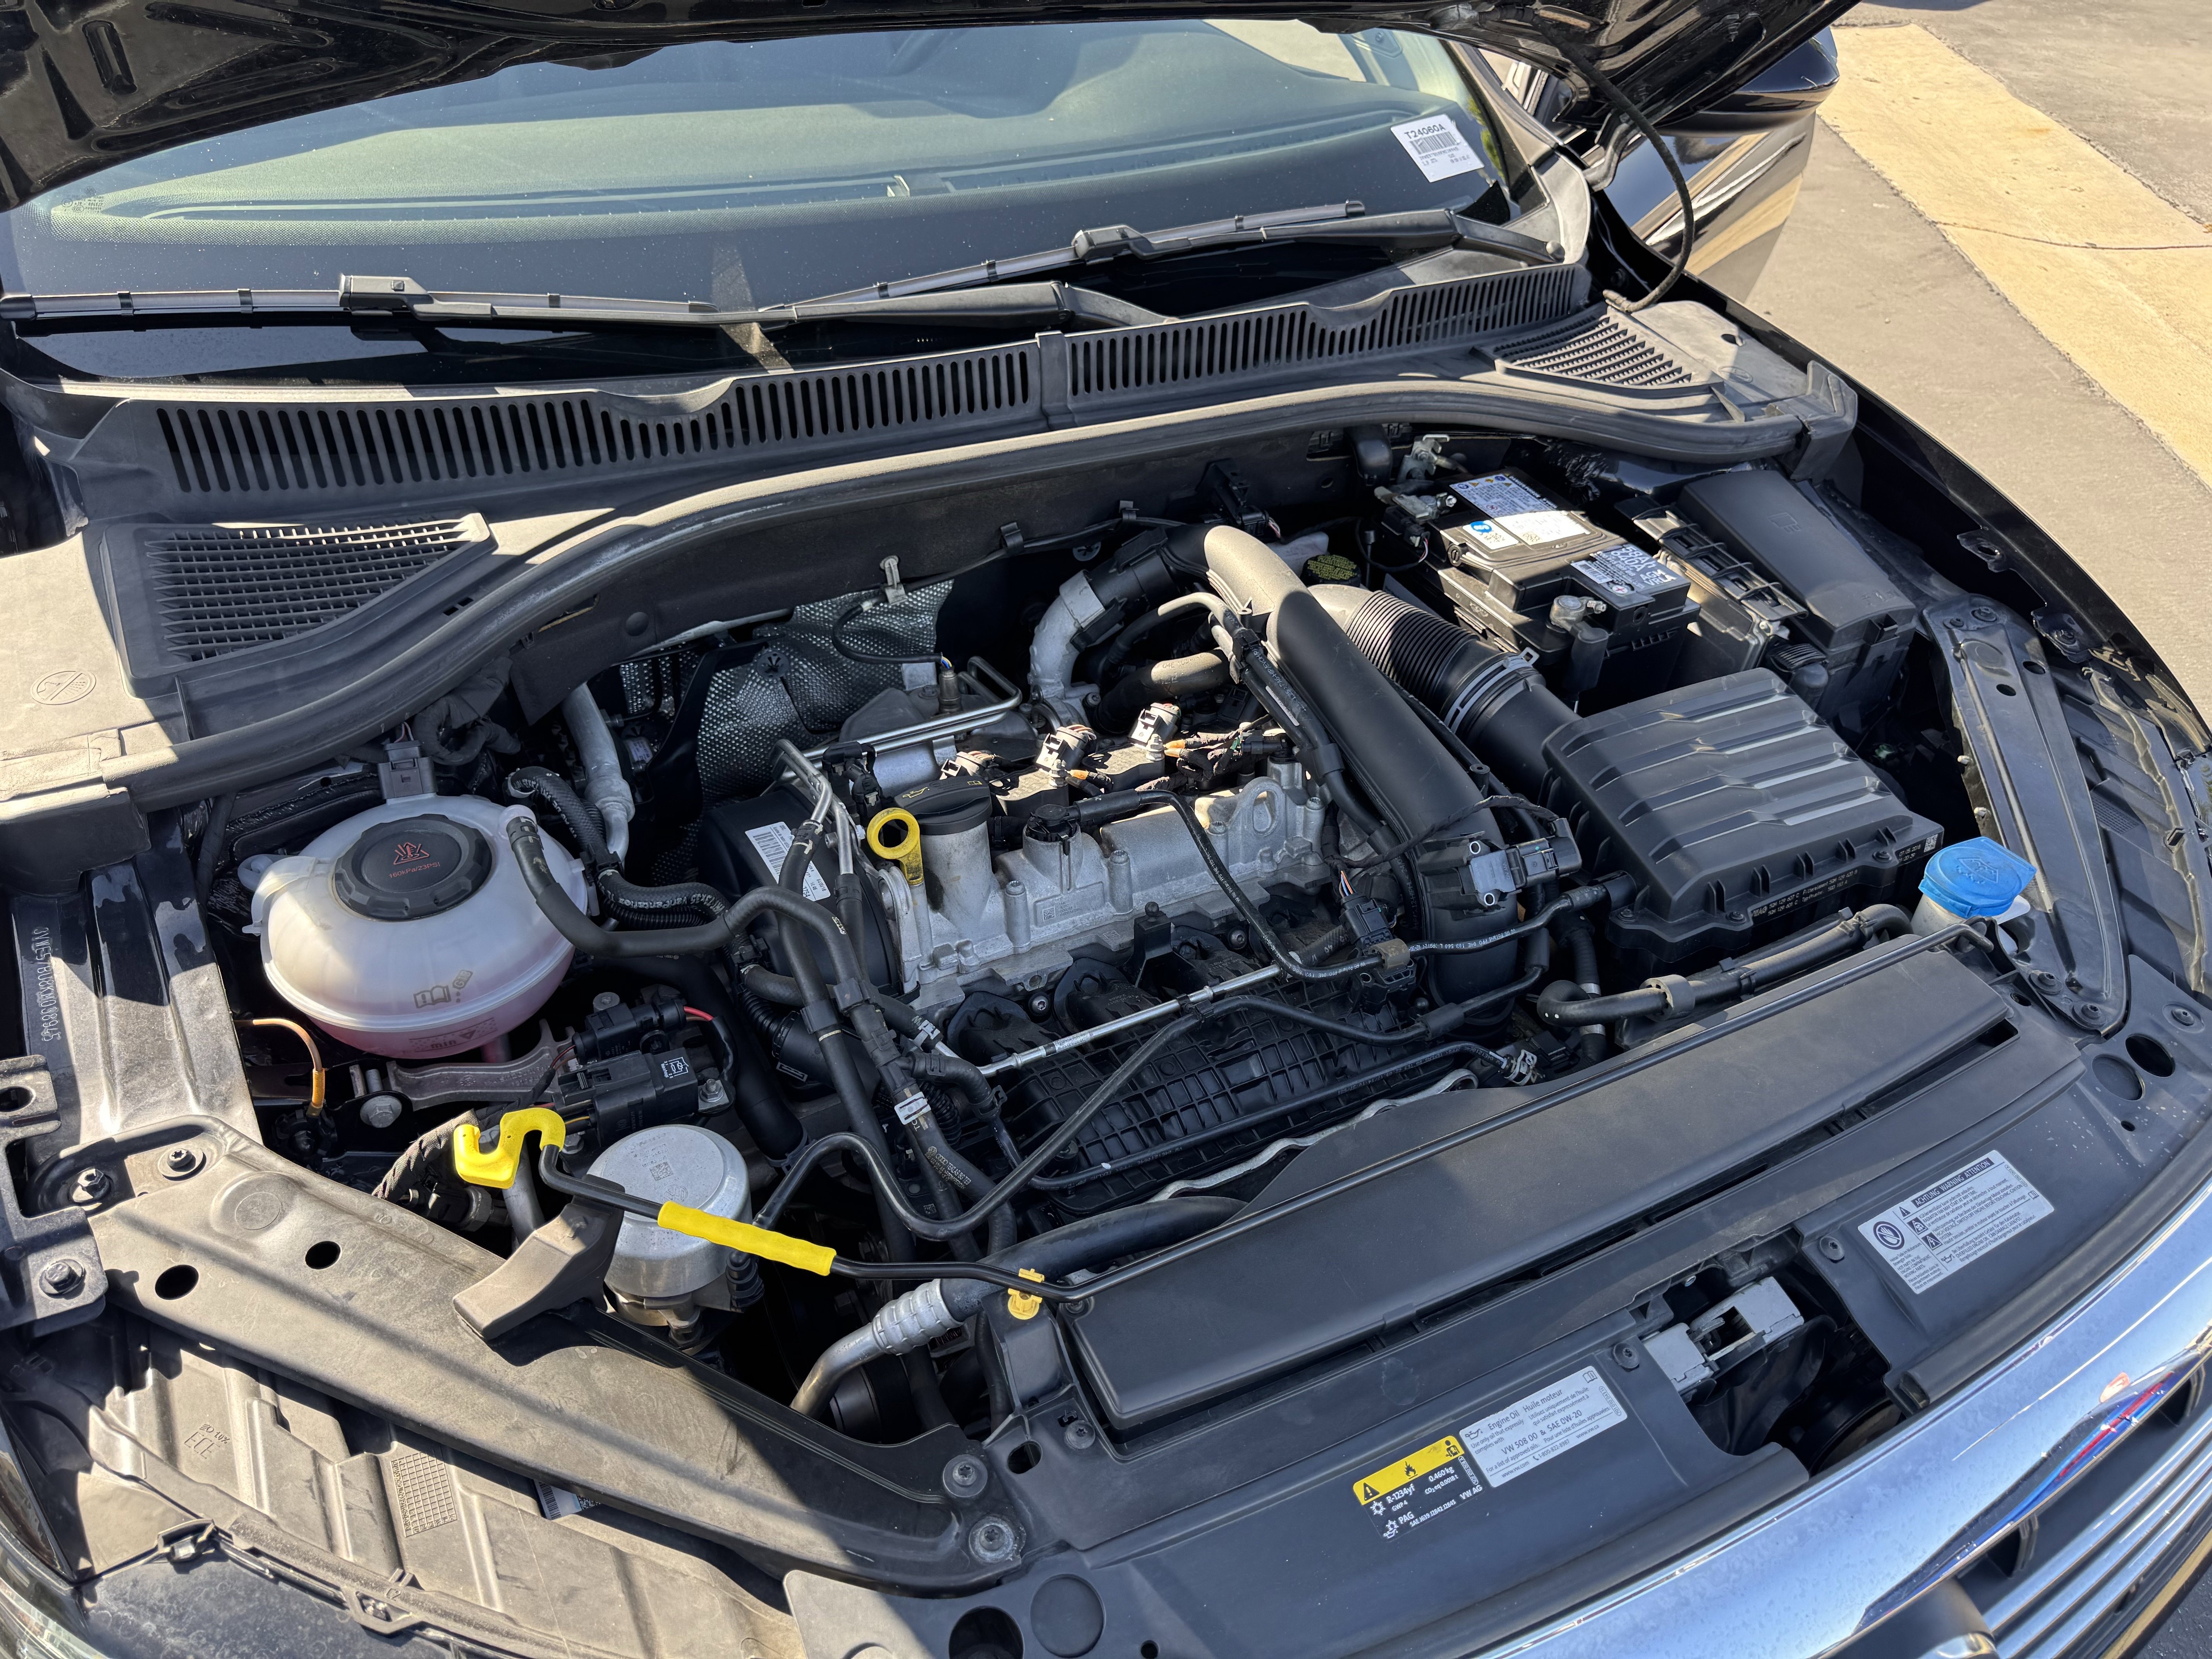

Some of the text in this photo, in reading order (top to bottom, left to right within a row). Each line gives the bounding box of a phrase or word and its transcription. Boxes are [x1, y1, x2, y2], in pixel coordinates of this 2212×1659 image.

[1403, 123, 1446, 139] T24060A
[1611, 551, 1645, 572] 640A
[1622, 546, 1657, 568] 58Ah
[1640, 569, 1666, 580] AGM
[1644, 574, 1677, 586] VRLA
[388, 860, 442, 879] 160kPa/23PSI
[1488, 933, 1504, 941] Poland
[431, 1037, 457, 1050] min
[946, 1162, 961, 1176] TEKLAS
[957, 1171, 965, 1180] BG
[1915, 1160, 1990, 1206] ACHTUNG WARNING ATTENTION
[1522, 1389, 1563, 1412] Huile moteur
[1528, 1409, 1545, 1420] Utilisez
[1544, 1396, 1571, 1412] uniquement
[1575, 1387, 1589, 1396] l'huile
[1487, 1409, 1520, 1430] Engine Oil
[1540, 1410, 1558, 1422] satisfait
[1494, 1428, 1505, 1436] that
[1504, 1419, 1524, 1432] expressly
[1501, 1444, 1515, 1455] VW
[1514, 1437, 1528, 1448] 508
[1527, 1432, 1538, 1441] 00
[1546, 1420, 1561, 1431] SAE
[1559, 1409, 1582, 1425] 0W-20
[1543, 1435, 1554, 1443] Pour
[1570, 1418, 1587, 1429] d'huiles
[1576, 1424, 1600, 1439] www.vw.ca
[184, 1431, 222, 1459] ECE
[1474, 1442, 1494, 1455] complies
[1538, 1439, 1570, 1458] 1-800-822-8987
[1510, 1448, 1530, 1461] approved
[1428, 1469, 1446, 1482] 0.460
[1501, 1461, 1530, 1478] www.vw.com
[1439, 1475, 1456, 1487] 0.0018
[1386, 1483, 1415, 1504] R-1234yf
[1459, 1484, 1482, 1499] VW AG
[1391, 1502, 1403, 1511] GWP
[1398, 1511, 1415, 1524] PAG
[1409, 1518, 1420, 1527] SAE
[1419, 1513, 1430, 1522] J639
[1429, 1506, 1443, 1516] J2842
